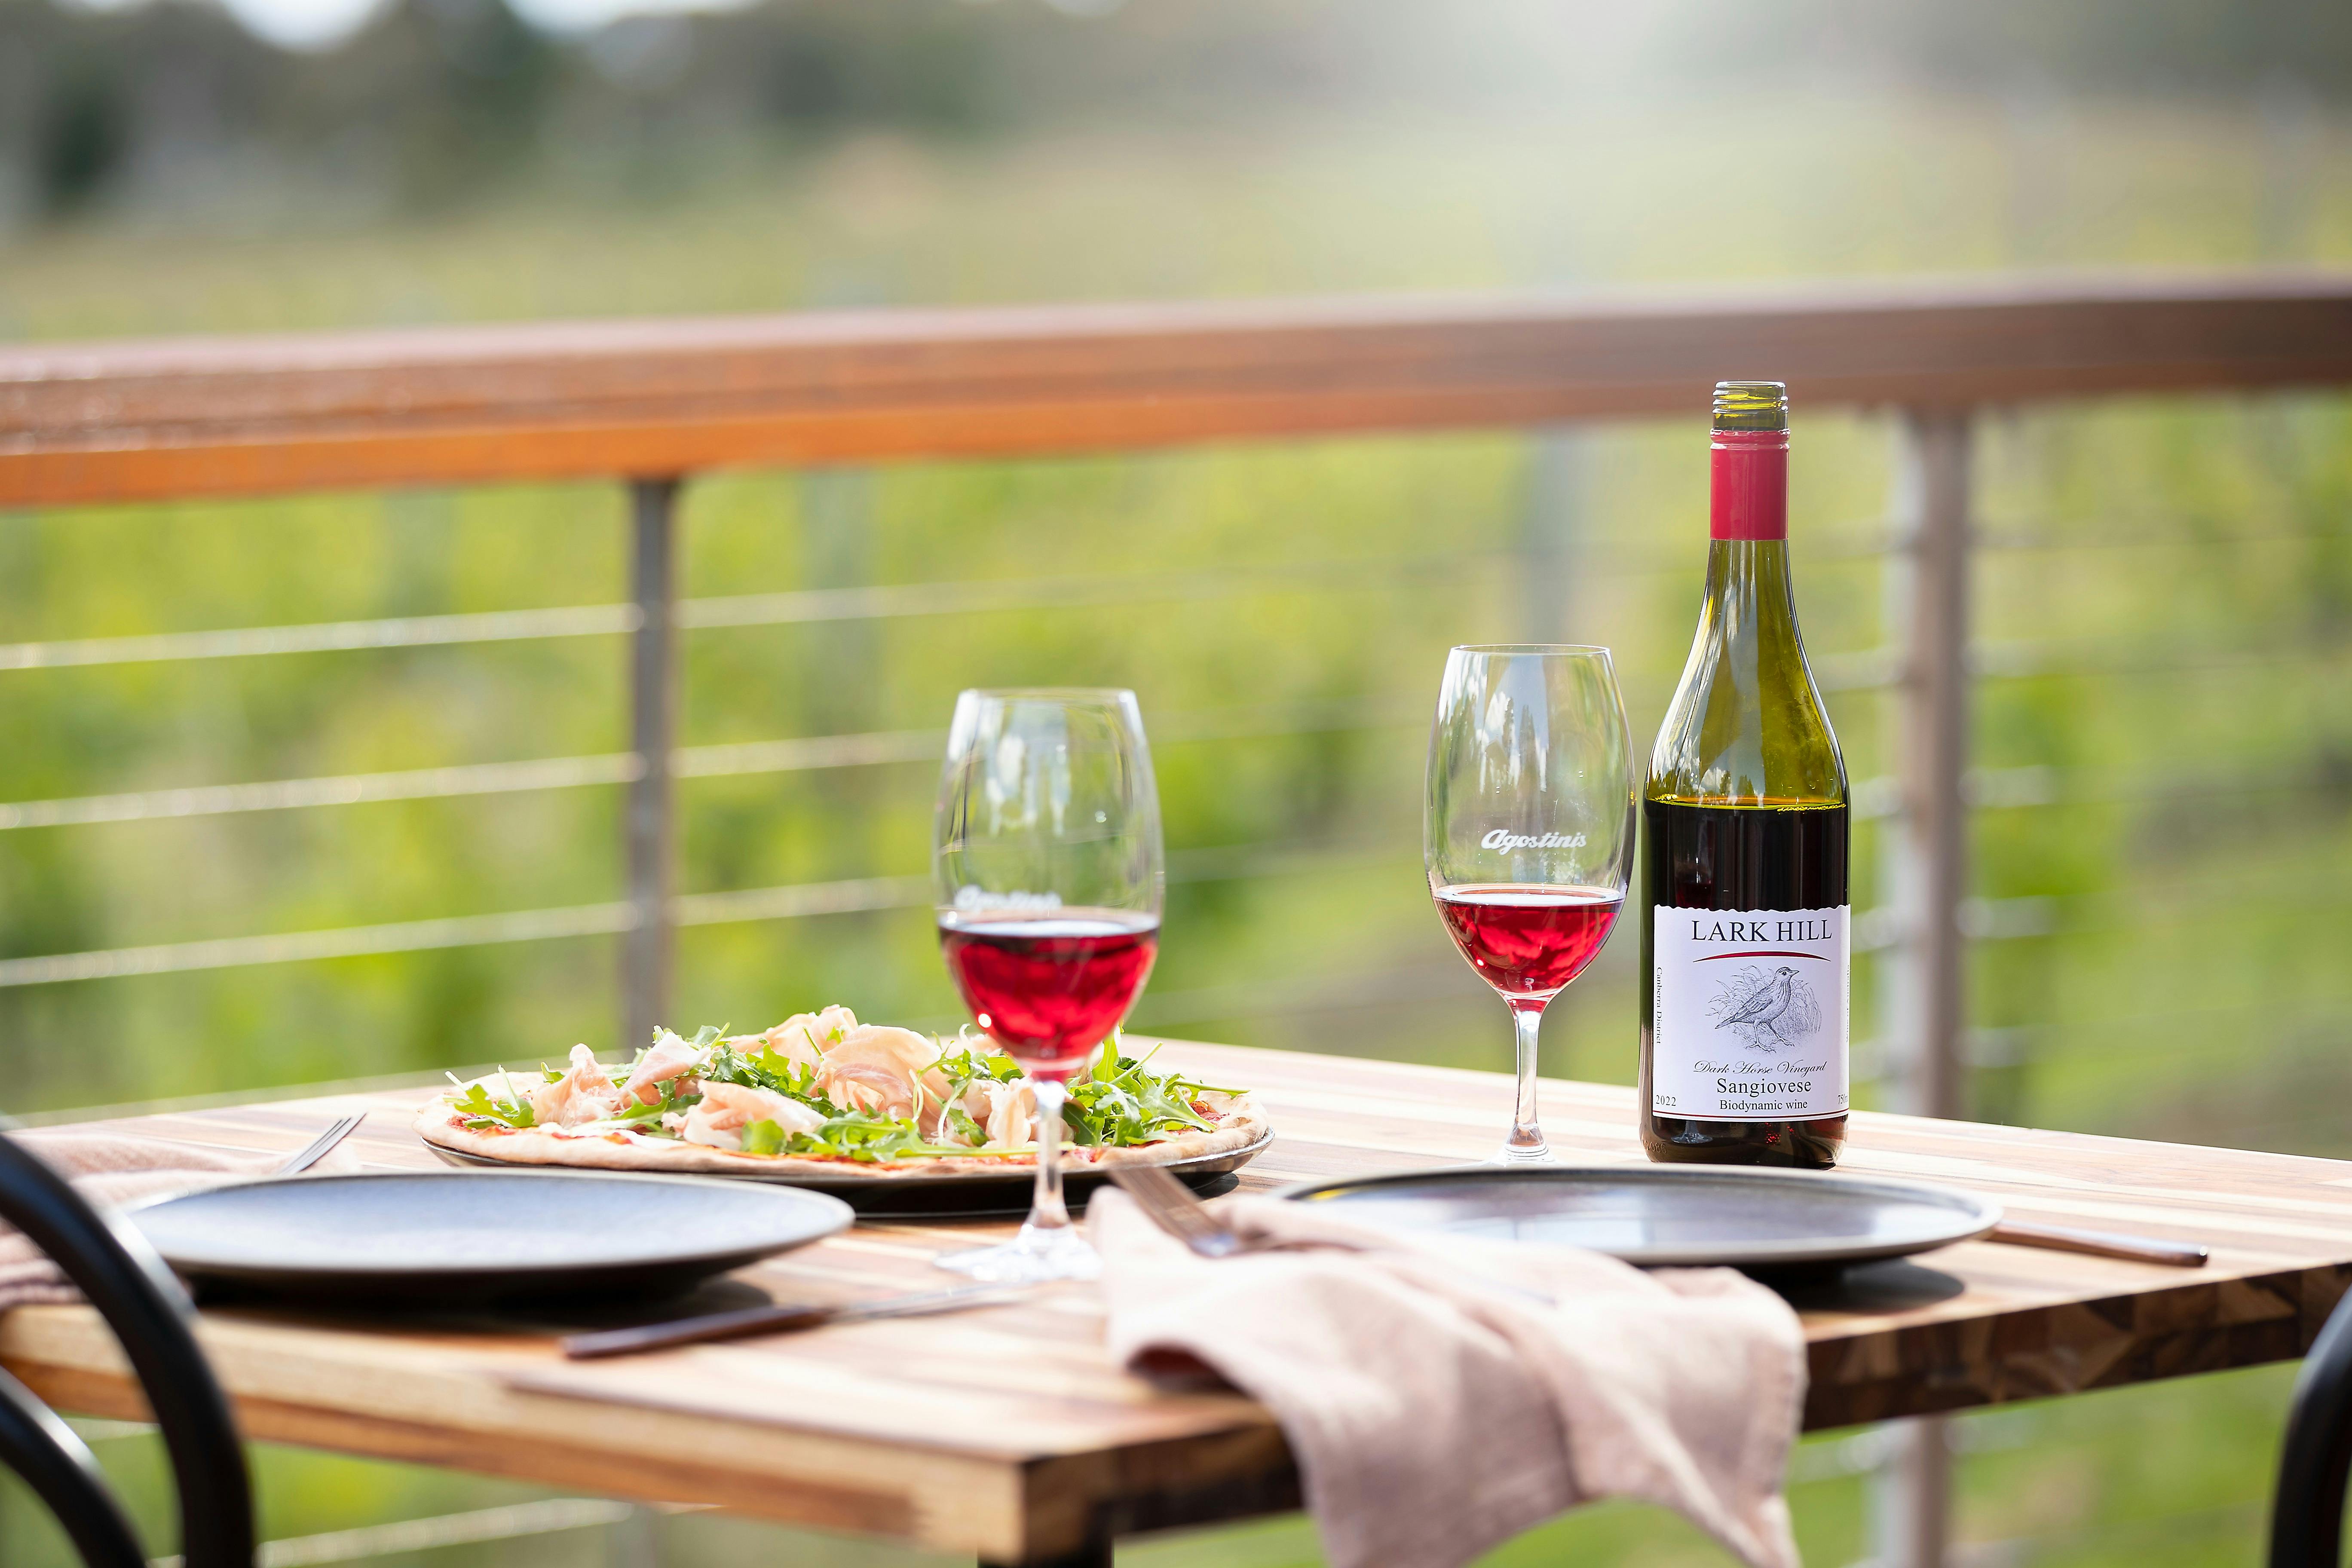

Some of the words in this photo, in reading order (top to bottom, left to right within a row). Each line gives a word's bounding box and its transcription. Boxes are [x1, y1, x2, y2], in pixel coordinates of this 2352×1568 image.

[1481, 829, 1586, 855] Agostinis
[1691, 920, 1770, 942] LARK
[1776, 919, 1832, 942] HILL
[1694, 1060, 1729, 1073] Dark
[1733, 1061, 1773, 1074] Horse
[1777, 1060, 1827, 1078] Vineyard
[1717, 1078, 1811, 1098] Sangiovese
[1656, 1094, 1676, 1106] 2022
[1719, 1099, 1782, 1112] Biodynamic
[1785, 1099, 1808, 1109] wine
